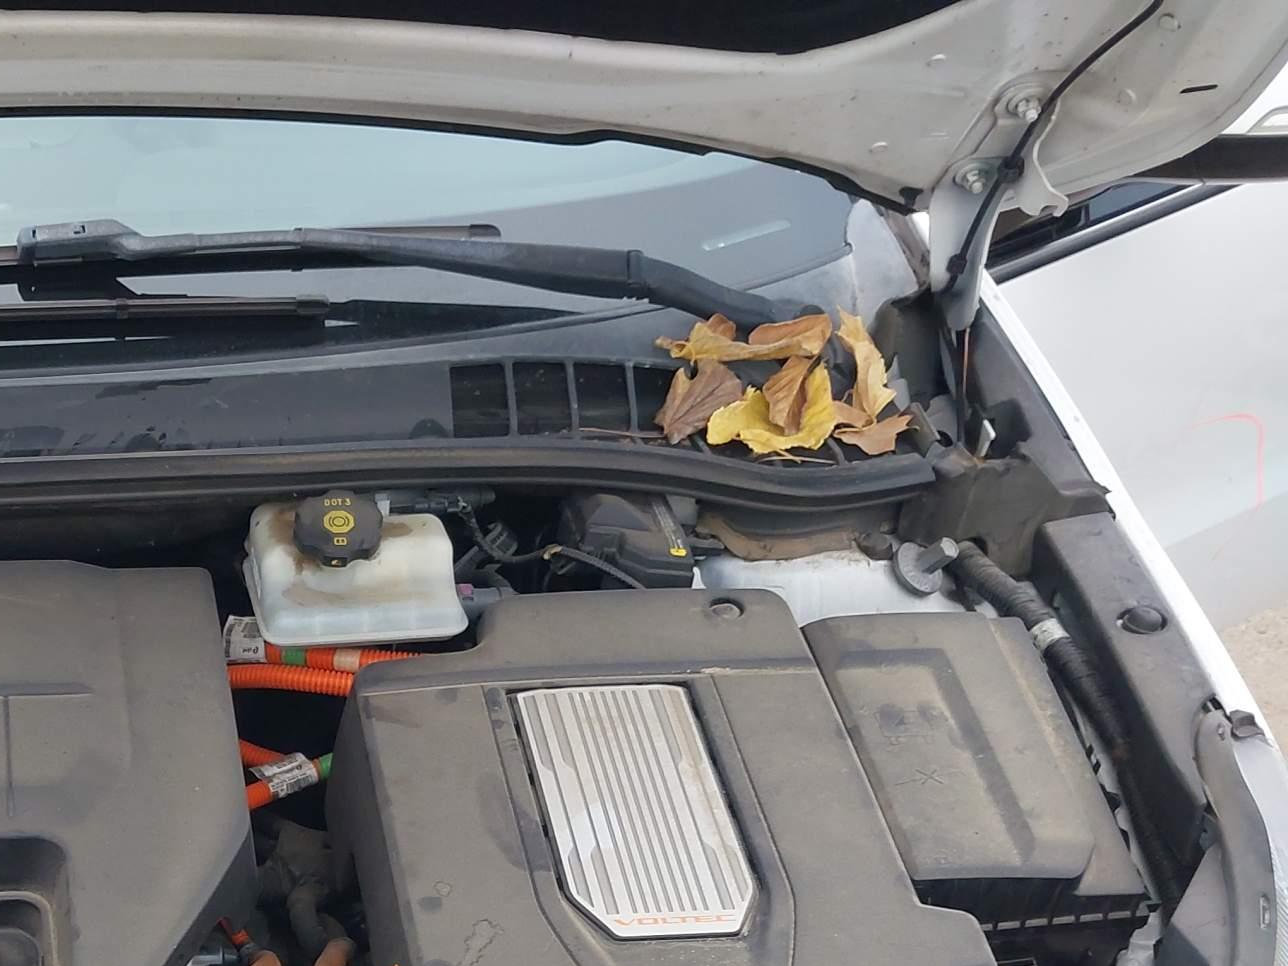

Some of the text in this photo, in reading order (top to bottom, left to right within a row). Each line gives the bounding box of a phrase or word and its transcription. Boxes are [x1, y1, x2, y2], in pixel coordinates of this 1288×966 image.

[323, 498, 352, 507] DOT 3
[614, 914, 737, 927] VOLTEC
